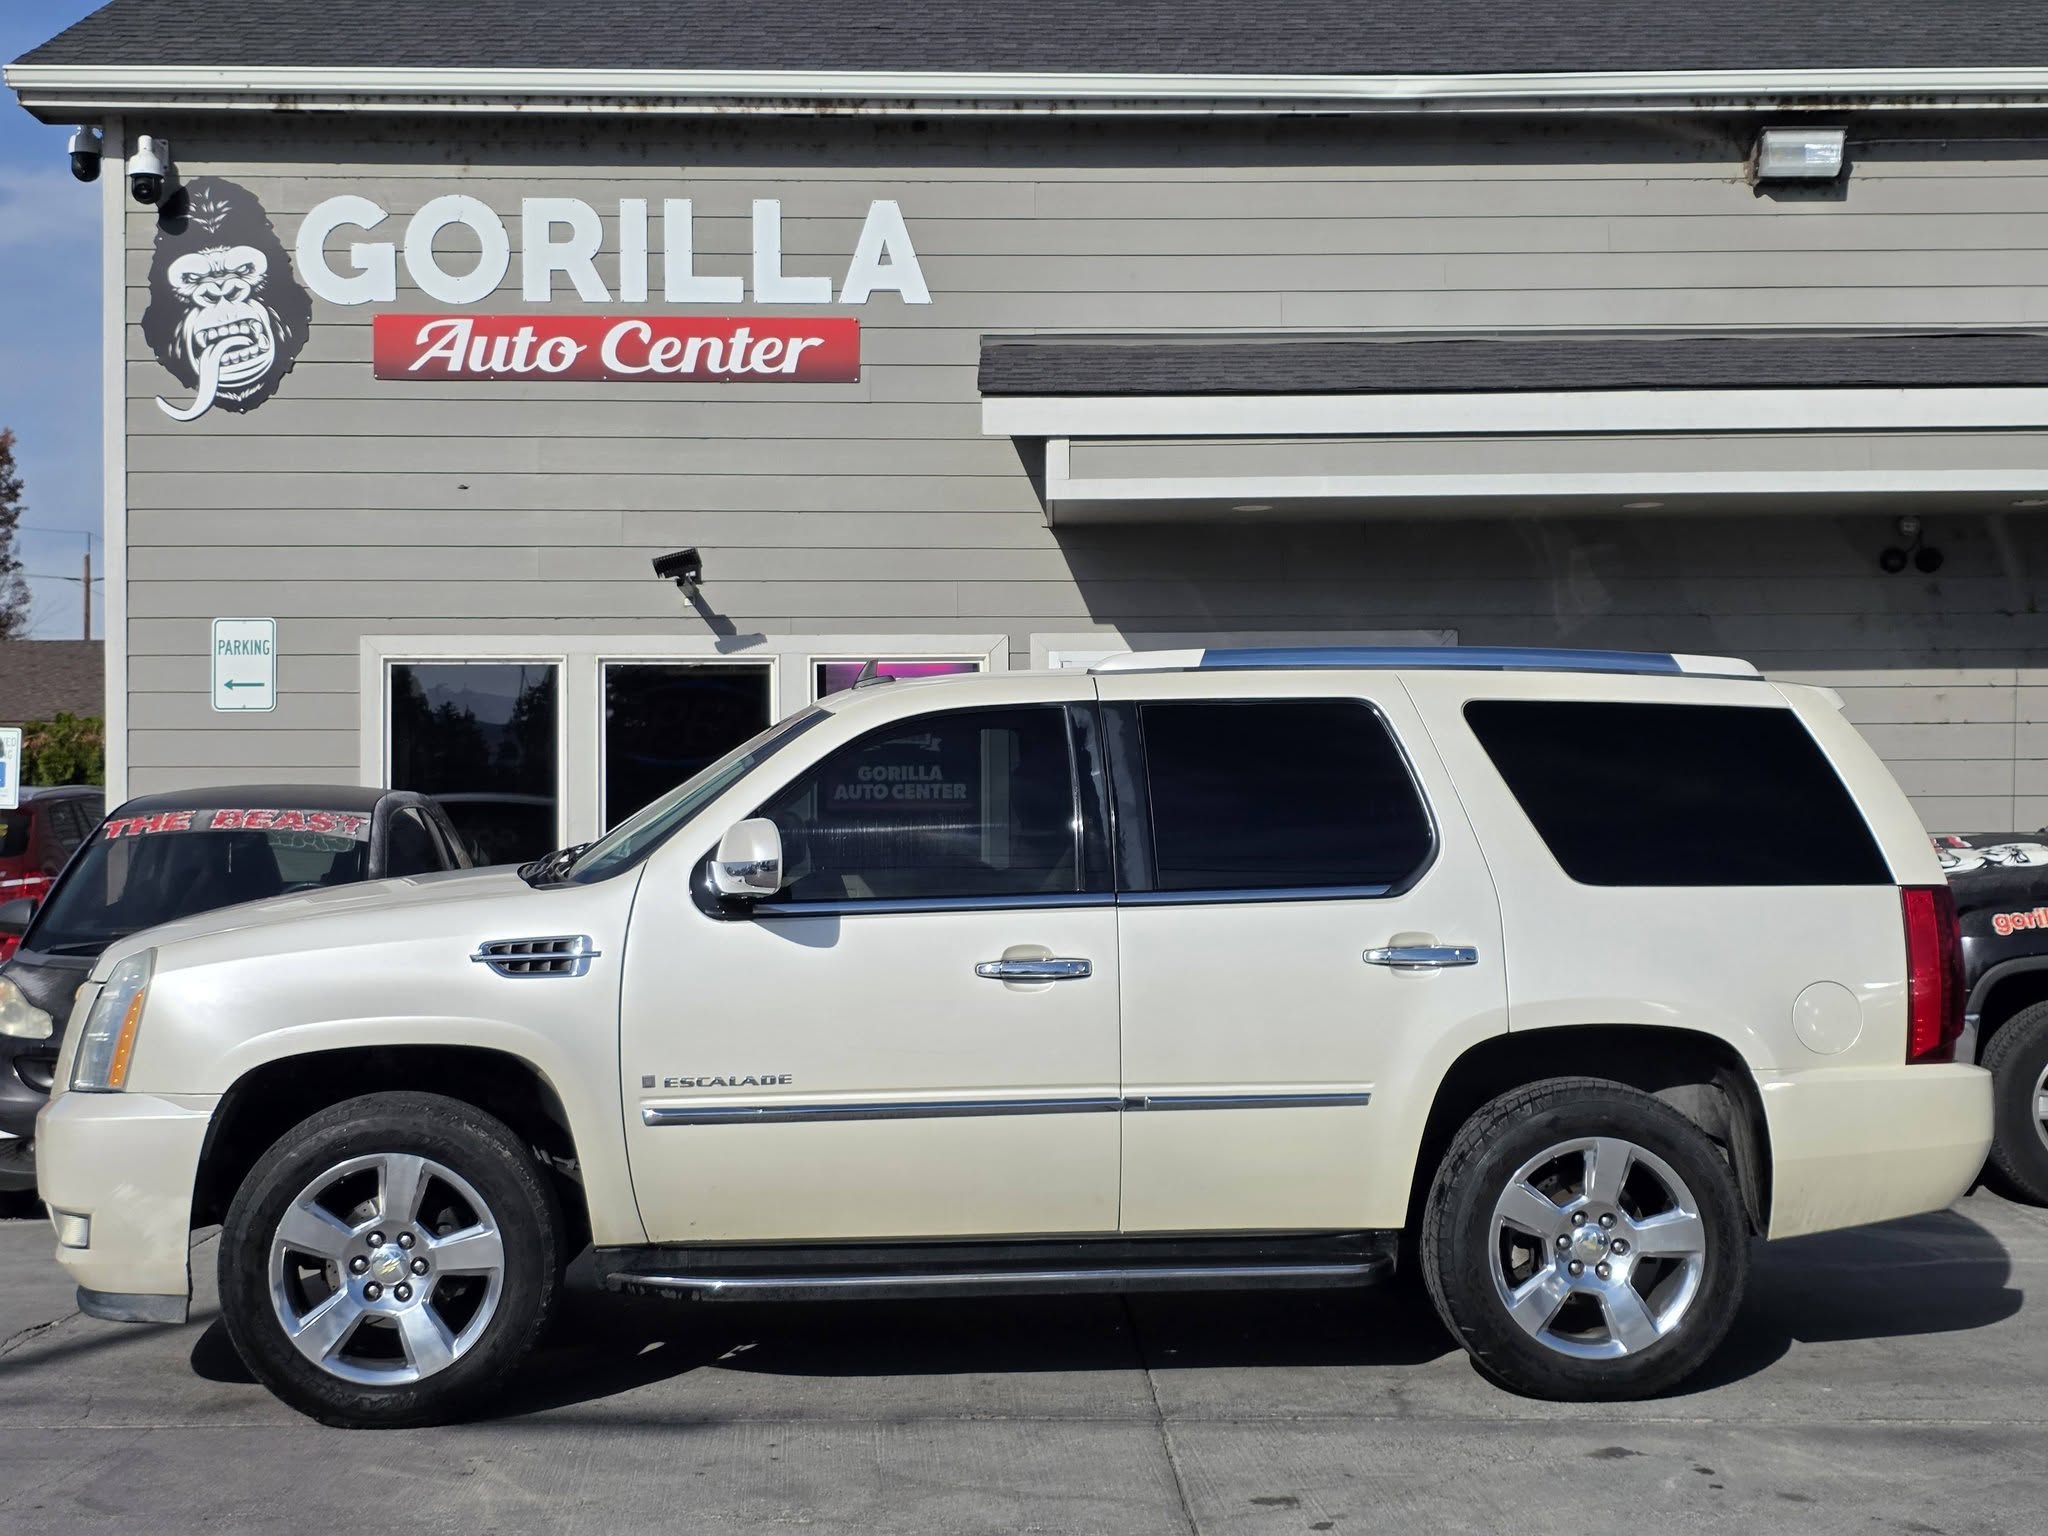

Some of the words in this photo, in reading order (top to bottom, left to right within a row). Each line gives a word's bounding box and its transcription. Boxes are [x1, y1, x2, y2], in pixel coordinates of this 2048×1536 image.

[296, 194, 932, 305] GORILLA
[408, 318, 588, 373] Auto
[600, 319, 825, 374] Center
[217, 639, 271, 656] PARKING
[857, 765, 943, 782] GORILLA
[834, 783, 889, 800] AUTO
[890, 783, 967, 800] CENTER
[103, 810, 196, 839] THE
[210, 808, 369, 834] BEAST
[664, 1073, 793, 1089] ESCALADE
